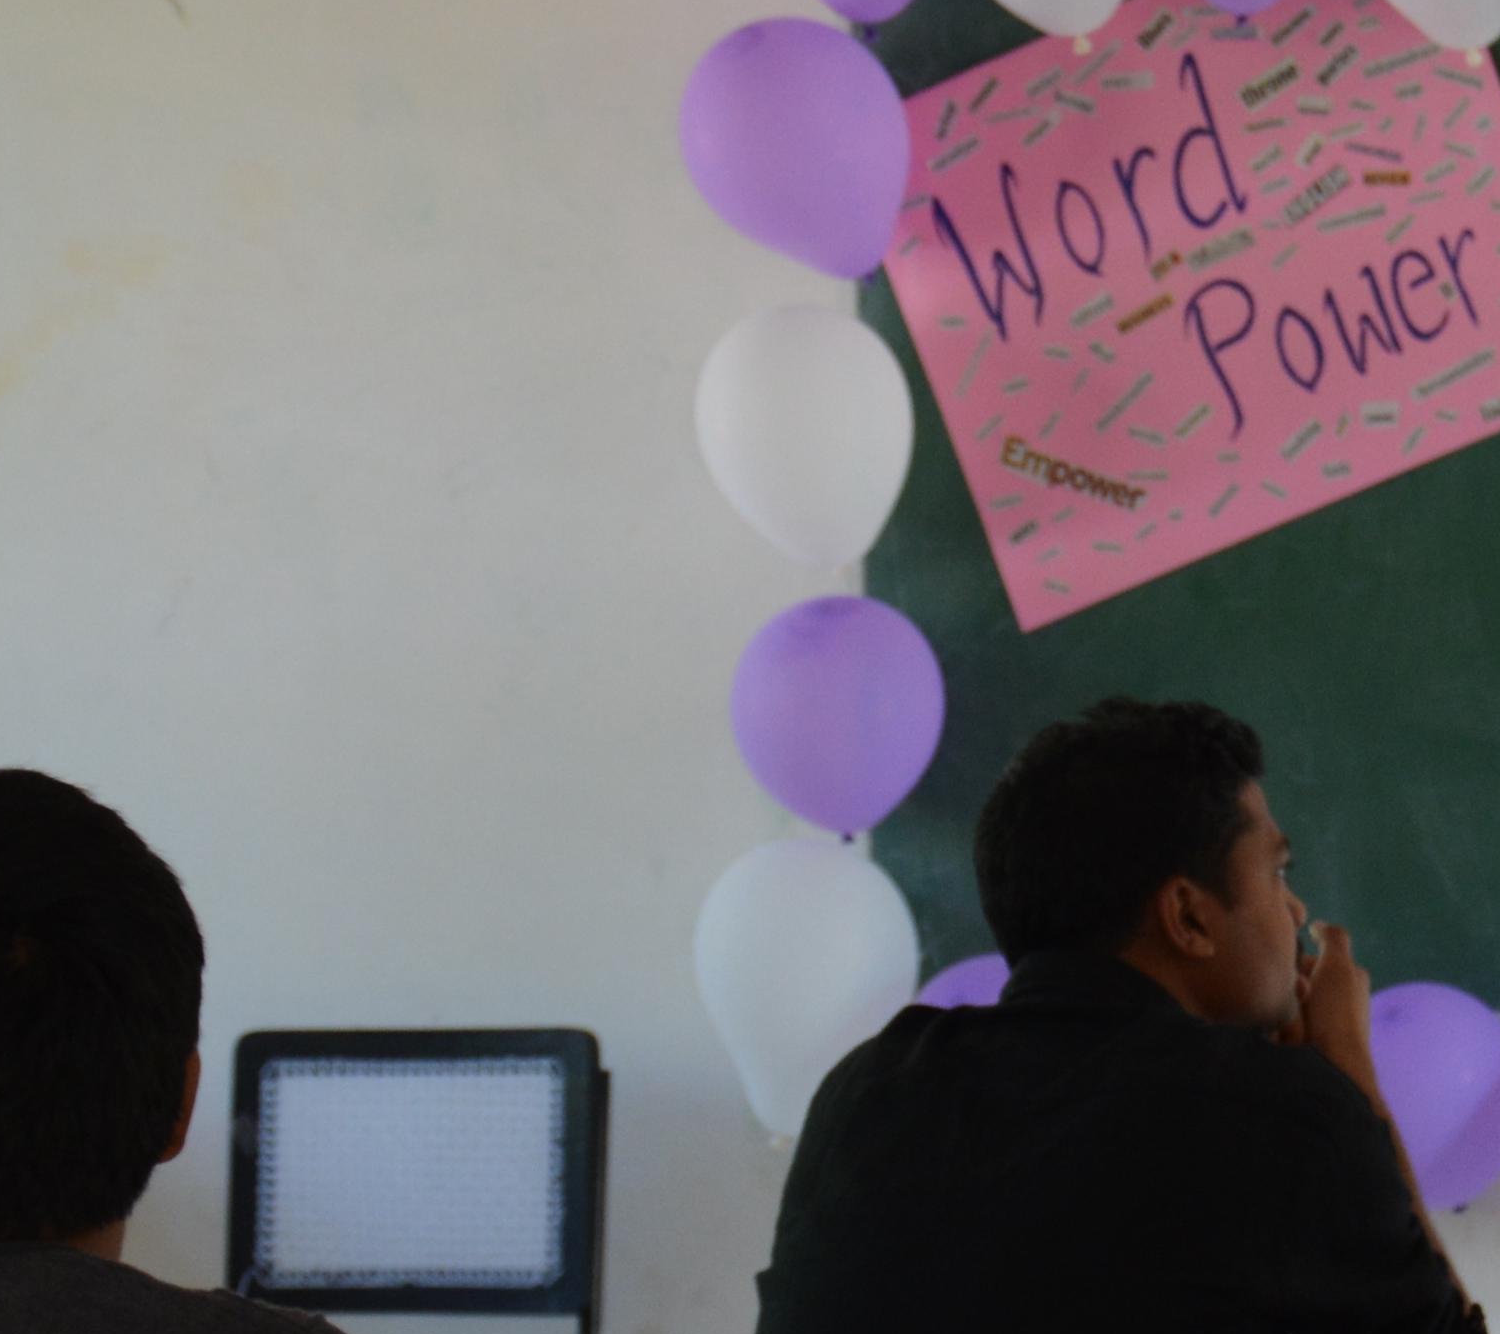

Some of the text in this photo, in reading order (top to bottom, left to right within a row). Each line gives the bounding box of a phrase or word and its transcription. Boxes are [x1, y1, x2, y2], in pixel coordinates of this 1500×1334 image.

[931, 50, 1248, 343] Word
[1183, 227, 1481, 440] Power
[1002, 435, 1148, 511] Empower
